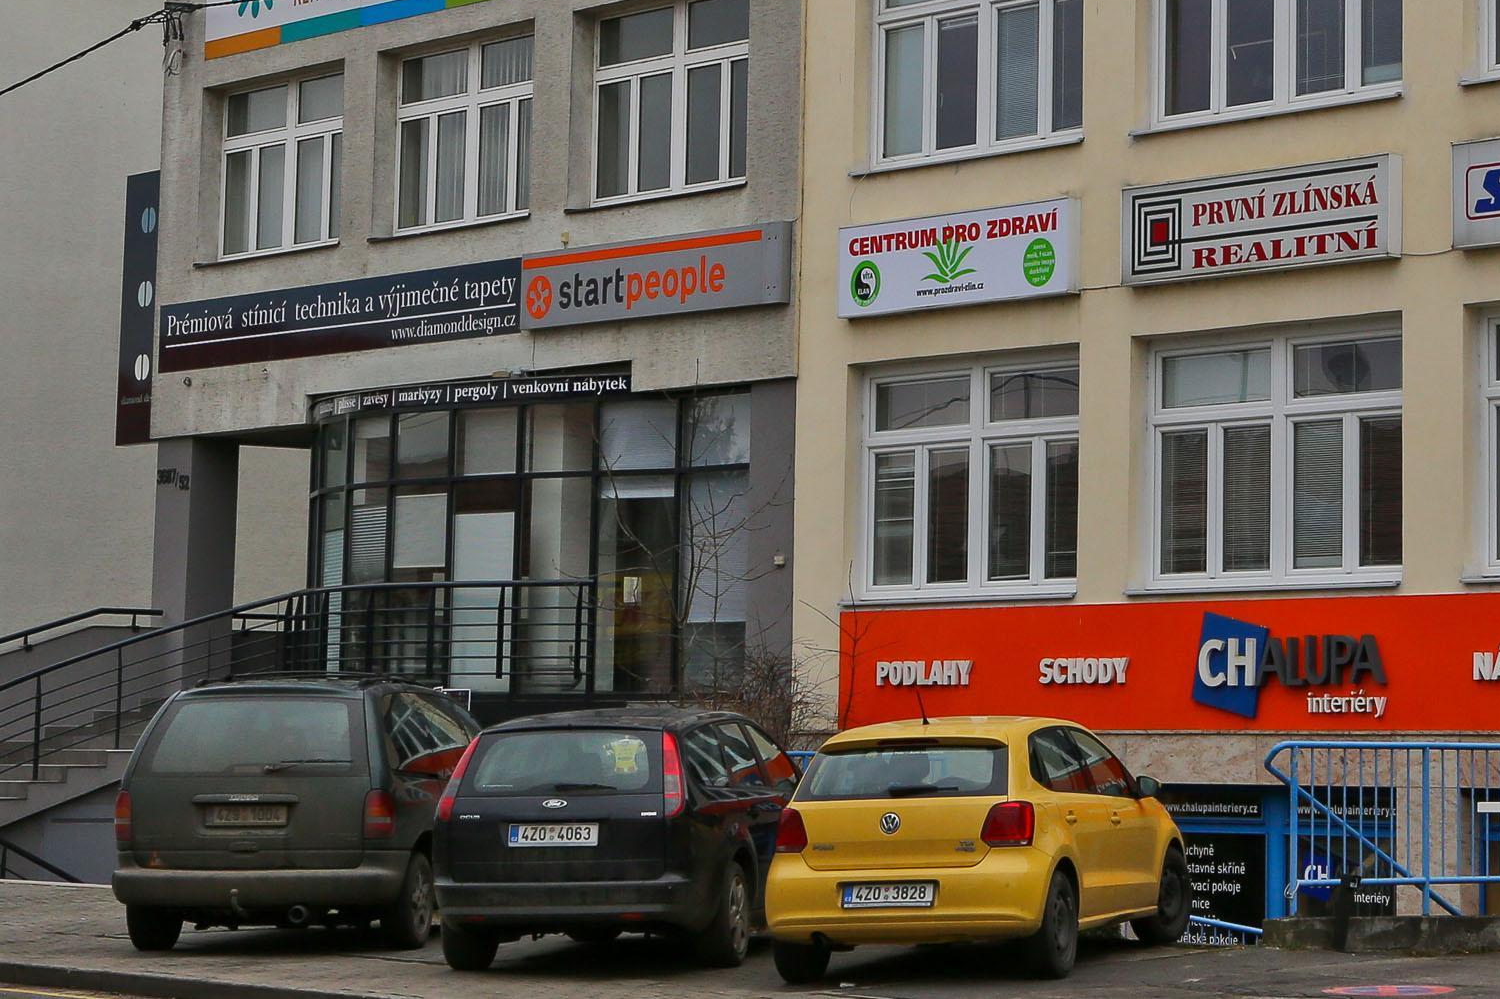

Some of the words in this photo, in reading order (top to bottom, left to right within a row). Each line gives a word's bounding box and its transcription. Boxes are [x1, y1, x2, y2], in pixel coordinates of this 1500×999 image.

[1192, 188, 1266, 227] PRVNÍ
[1272, 175, 1379, 217] ZLÍNSKÁ
[848, 228, 938, 257] CENTRUM
[941, 222, 982, 245] PRO
[986, 207, 1059, 240] ZDRAVÍ
[1192, 221, 1379, 269] REALITNÍ
[558, 255, 726, 310] startpeople
[166, 307, 233, 337] Prémiová
[241, 299, 286, 328] stínicí
[295, 291, 361, 321] technika
[365, 294, 374, 312] a
[378, 278, 460, 318] výjimečné
[464, 275, 517, 306] tapety
[391, 310, 517, 341] www.diamonddesign.cz
[399, 386, 442, 403] markýzy
[454, 383, 499, 400] pergoly
[512, 378, 569, 395] venkovní
[573, 375, 628, 392] nábytek
[875, 659, 973, 686] PODLAHY
[1038, 656, 1129, 685] SCHODY
[1198, 634, 1388, 688] CHALUPA
[1307, 688, 1388, 718] interiéry
[1164, 802, 1259, 816] ww.chalupainteriery.cz
[557, 826, 591, 841] 4063
[892, 884, 926, 900] 3828
[1212, 881, 1241, 895] pokoje
[1353, 891, 1391, 906] interiéry
